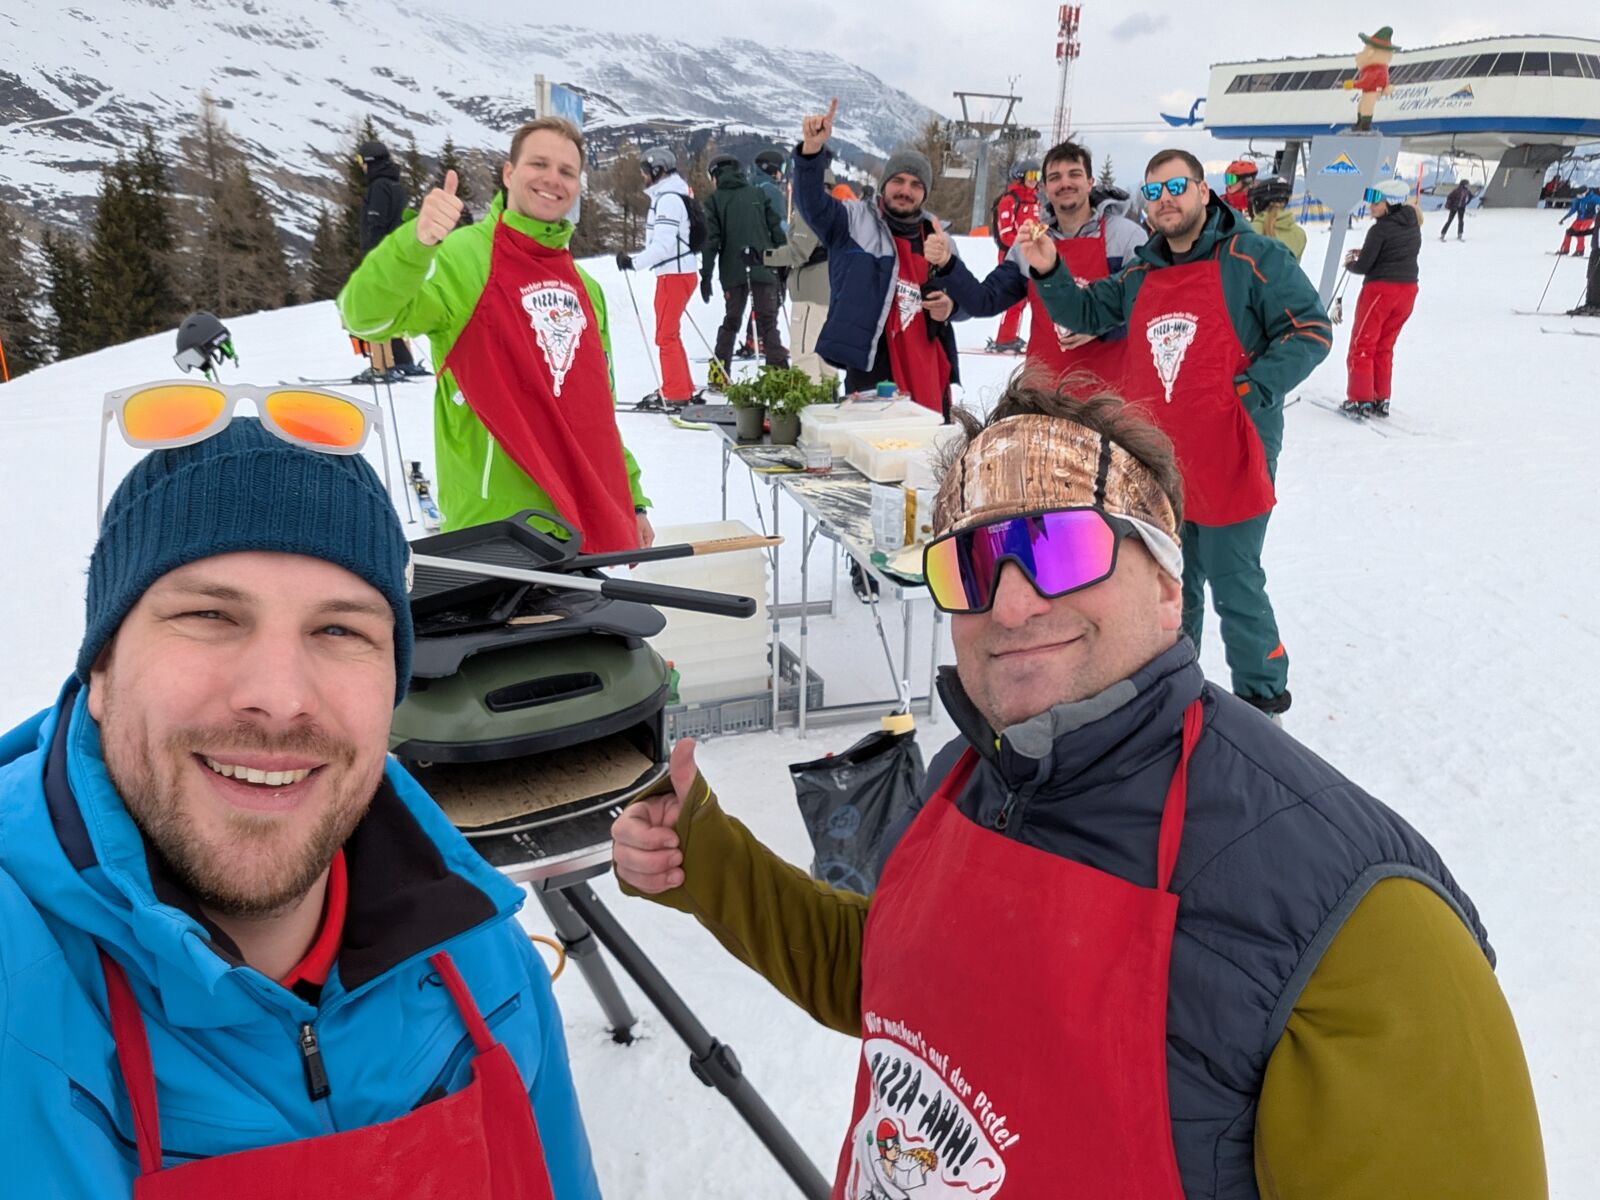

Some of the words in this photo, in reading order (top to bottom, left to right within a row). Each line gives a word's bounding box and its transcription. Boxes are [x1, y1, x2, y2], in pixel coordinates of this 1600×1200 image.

[865, 1011, 881, 1034] Wir
[883, 1018, 927, 1059] machen's
[928, 1047, 950, 1078] auf
[950, 1067, 972, 1097] der
[972, 1091, 1021, 1151] Piste!
